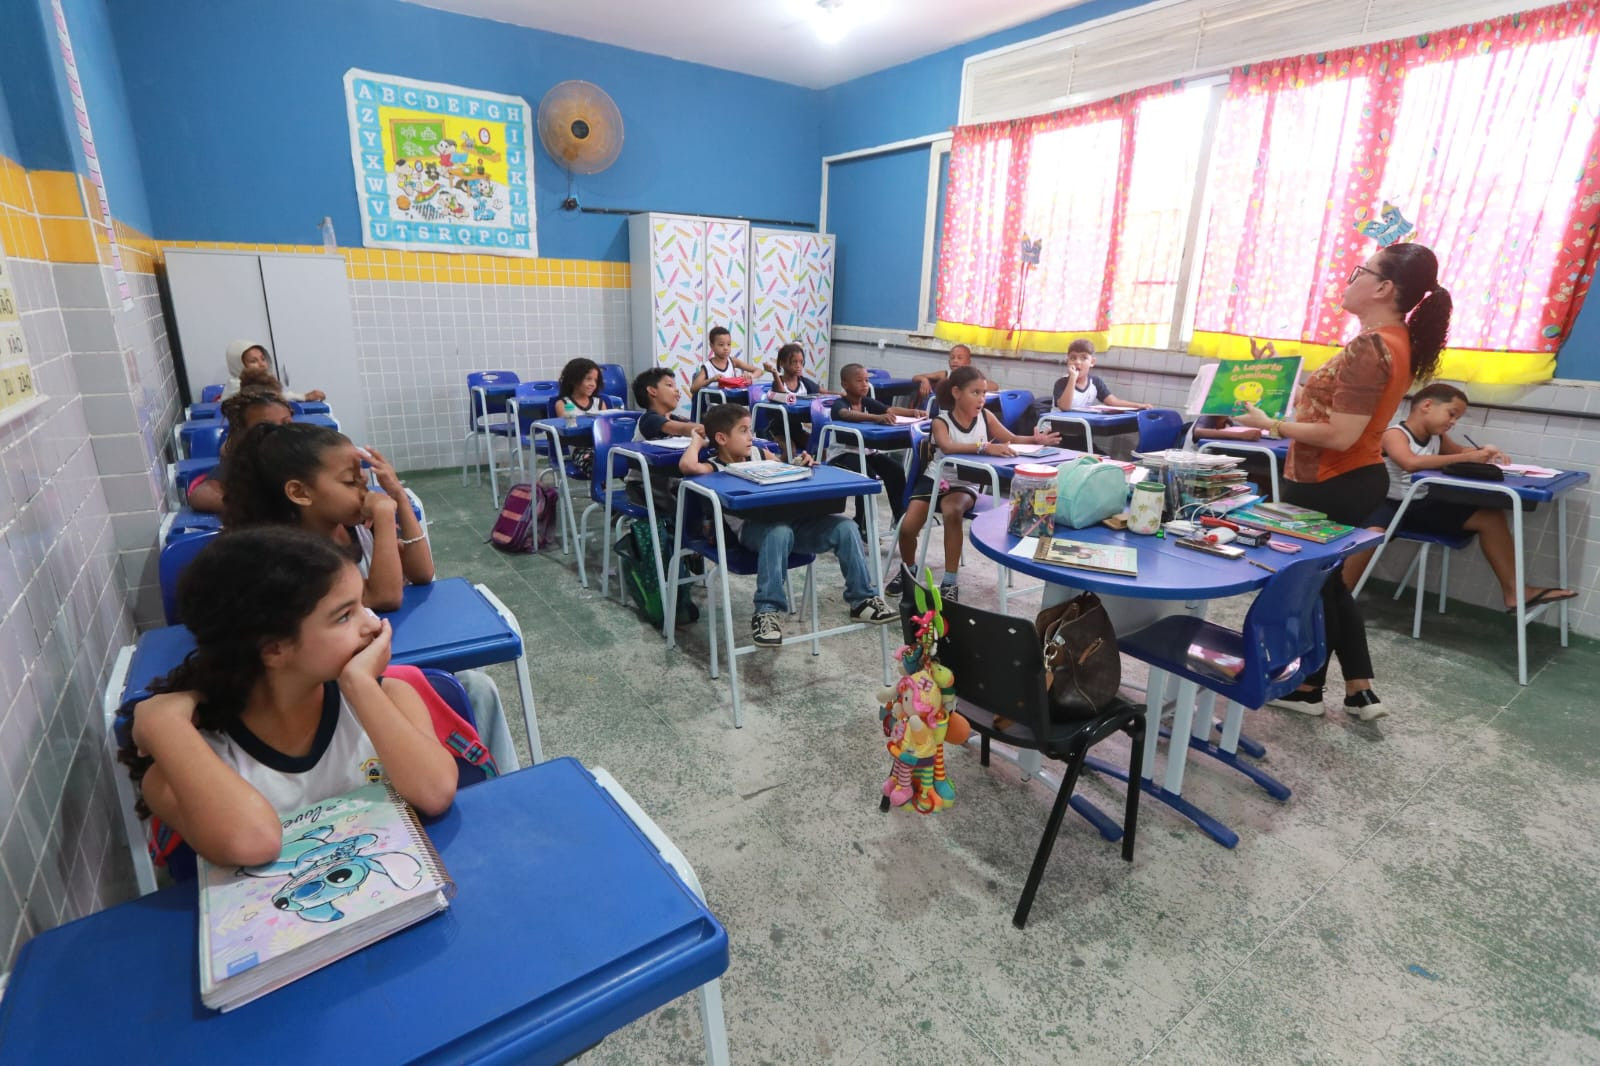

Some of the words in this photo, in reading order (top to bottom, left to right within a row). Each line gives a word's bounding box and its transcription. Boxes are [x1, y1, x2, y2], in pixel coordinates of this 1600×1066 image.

[359, 85, 372, 99] A
[382, 87, 395, 102] B
[404, 92, 416, 105] C
[426, 95, 439, 108] D
[448, 98, 459, 112] E
[469, 101, 480, 115] F
[488, 105, 500, 118] G
[507, 108, 519, 122] H
[362, 108, 374, 122] Z
[364, 131, 376, 146] Y
[511, 129, 518, 142] I
[366, 155, 381, 169] X
[511, 152, 520, 163] J
[367, 177, 384, 192] W
[512, 171, 523, 185] K
[514, 192, 523, 204] L
[371, 200, 385, 214] V
[514, 212, 526, 225] M
[374, 223, 387, 237] U
[396, 225, 407, 238] T
[419, 227, 430, 239] S
[439, 228, 451, 240] R
[459, 229, 471, 244] Q
[479, 230, 489, 242] P
[497, 232, 508, 244] O
[515, 233, 525, 244] N
